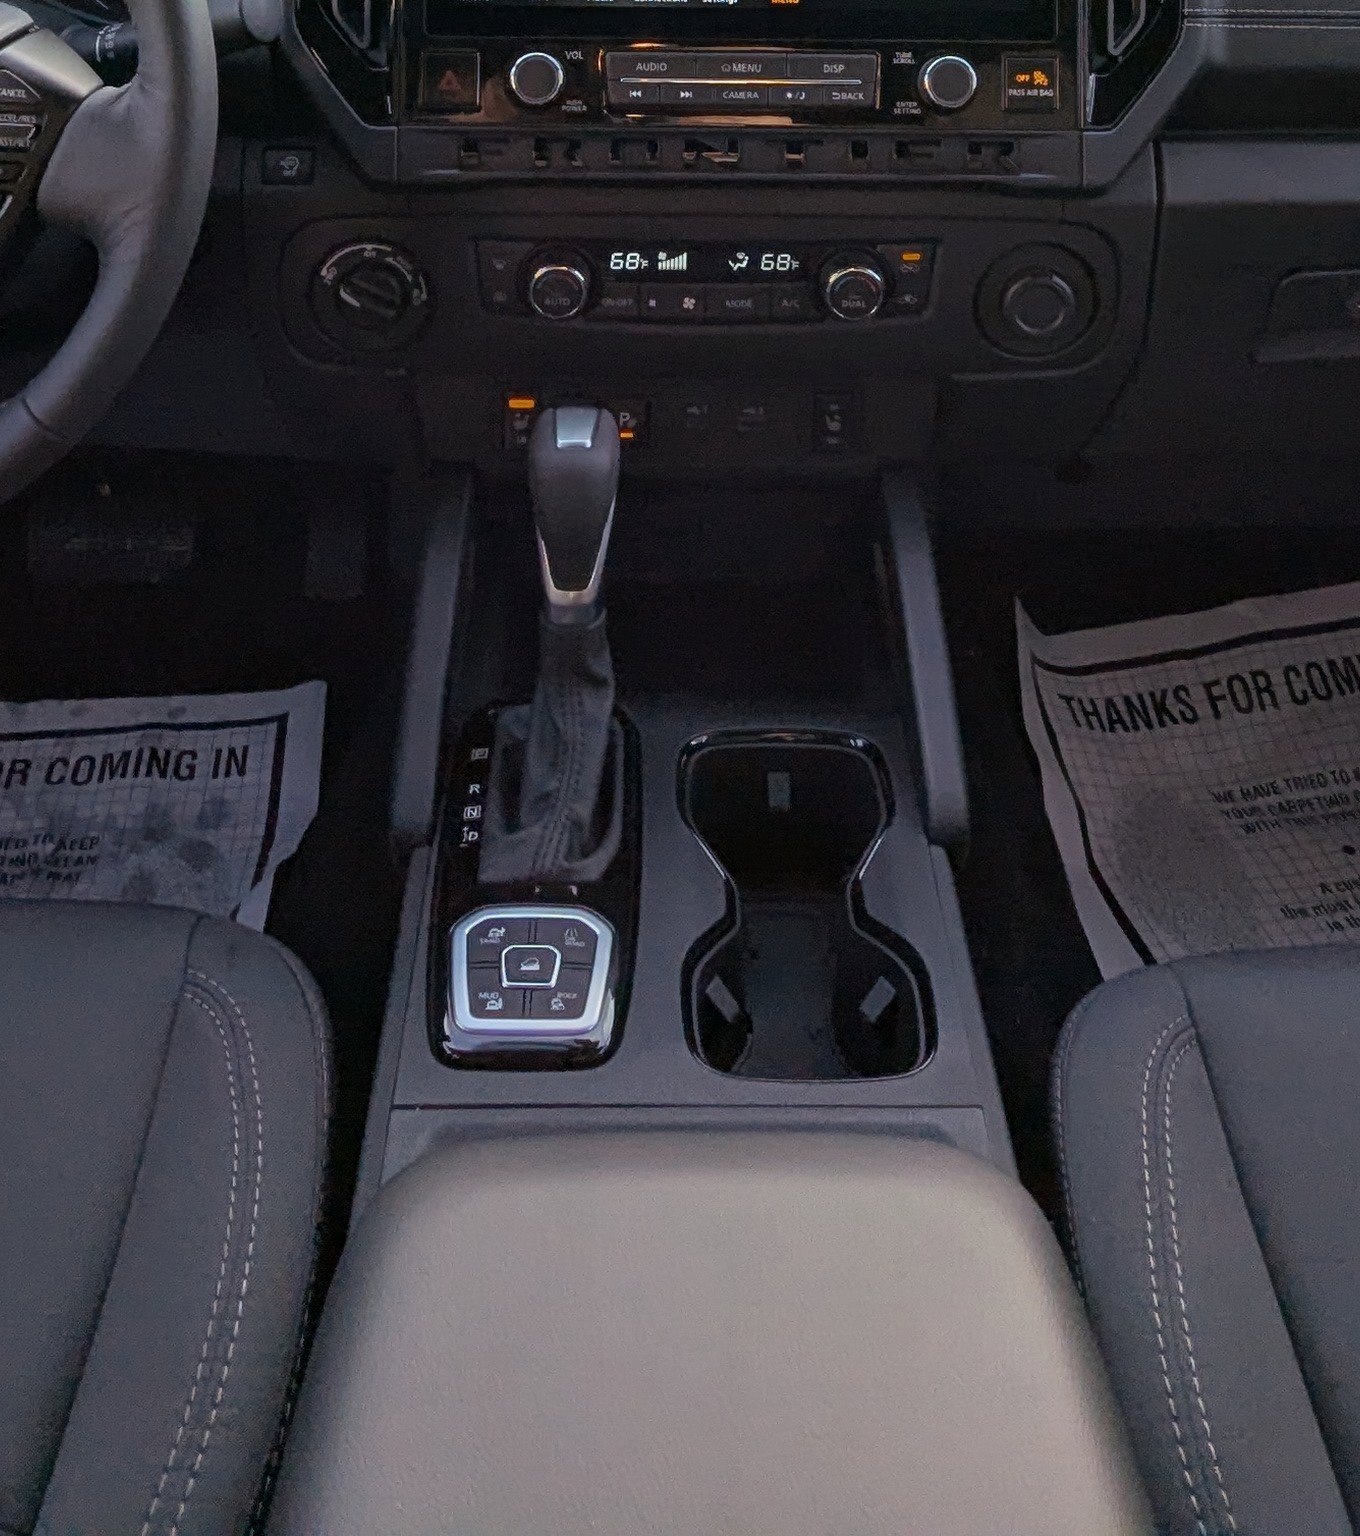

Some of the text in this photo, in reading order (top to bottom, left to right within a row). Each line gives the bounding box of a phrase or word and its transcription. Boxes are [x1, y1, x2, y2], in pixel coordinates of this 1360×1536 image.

[564, 50, 584, 61] VOL
[635, 62, 668, 73] AUDIO
[732, 63, 762, 73] MENU
[822, 63, 845, 74] DISP
[1015, 74, 1031, 83] OFF
[722, 90, 760, 100] CAMERA
[841, 91, 865, 101] BACK
[1008, 88, 1025, 97] PASS
[1060, 683, 1200, 734] THANKS
[1204, 669, 1278, 719] FOR
[44, 746, 198, 787] COMING
[210, 745, 250, 780] IN
[1211, 788, 1235, 804] WE
[1238, 780, 1282, 802] HAVE
[1282, 772, 1329, 793] TRIED
[1330, 768, 1352, 786] TO
[1317, 882, 1334, 896] A
[1311, 899, 1354, 917] most
